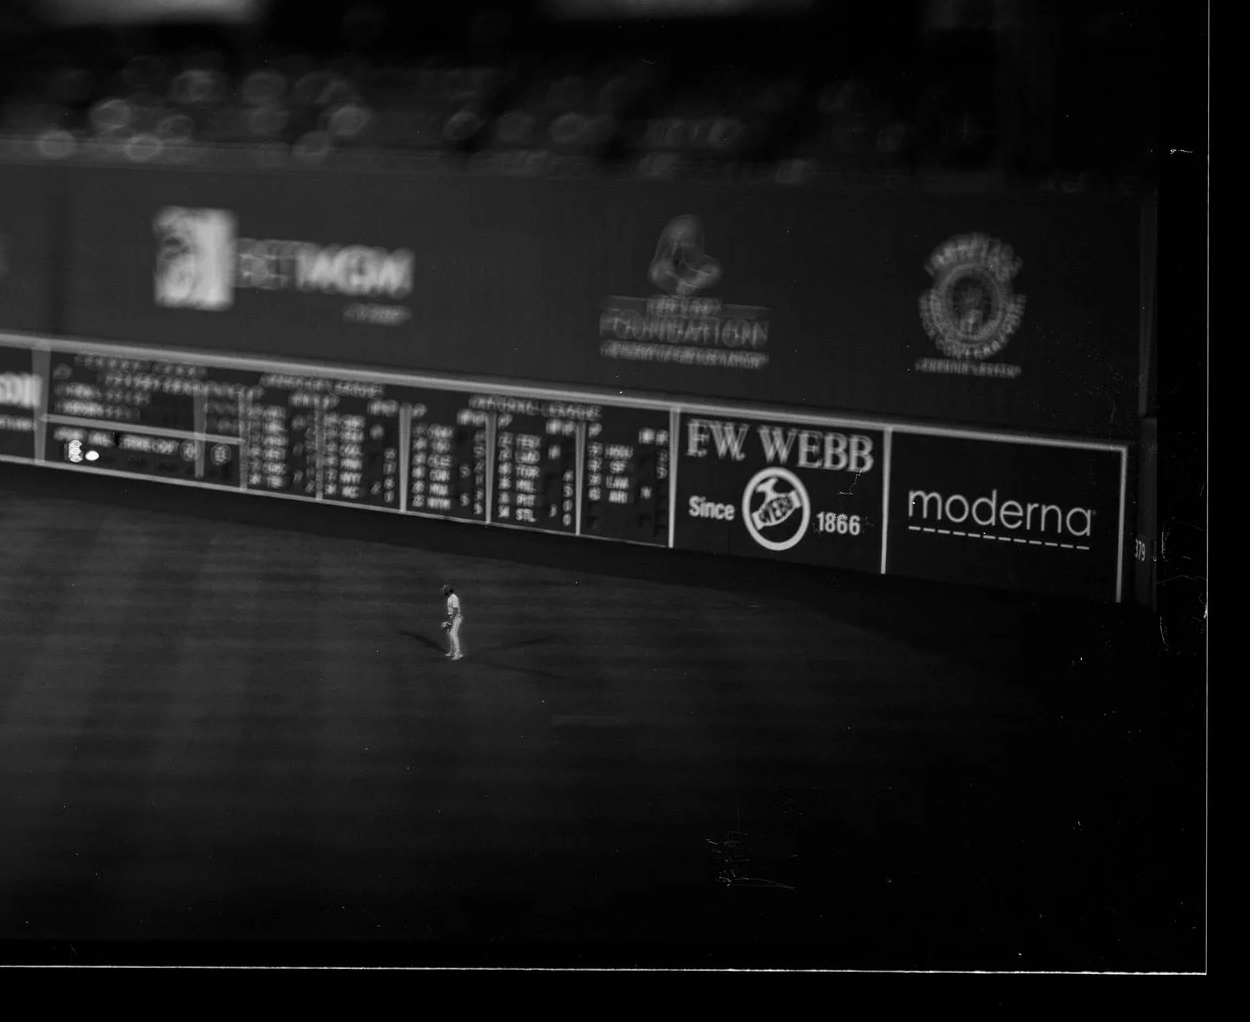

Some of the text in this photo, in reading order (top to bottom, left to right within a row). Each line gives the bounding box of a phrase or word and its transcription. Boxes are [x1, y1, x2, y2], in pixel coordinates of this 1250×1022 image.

[756, 425, 874, 473] WEBB
[515, 507, 537, 522] STL
[688, 495, 736, 521] Since
[908, 489, 1091, 536] moderna
[817, 511, 862, 536] 1866
